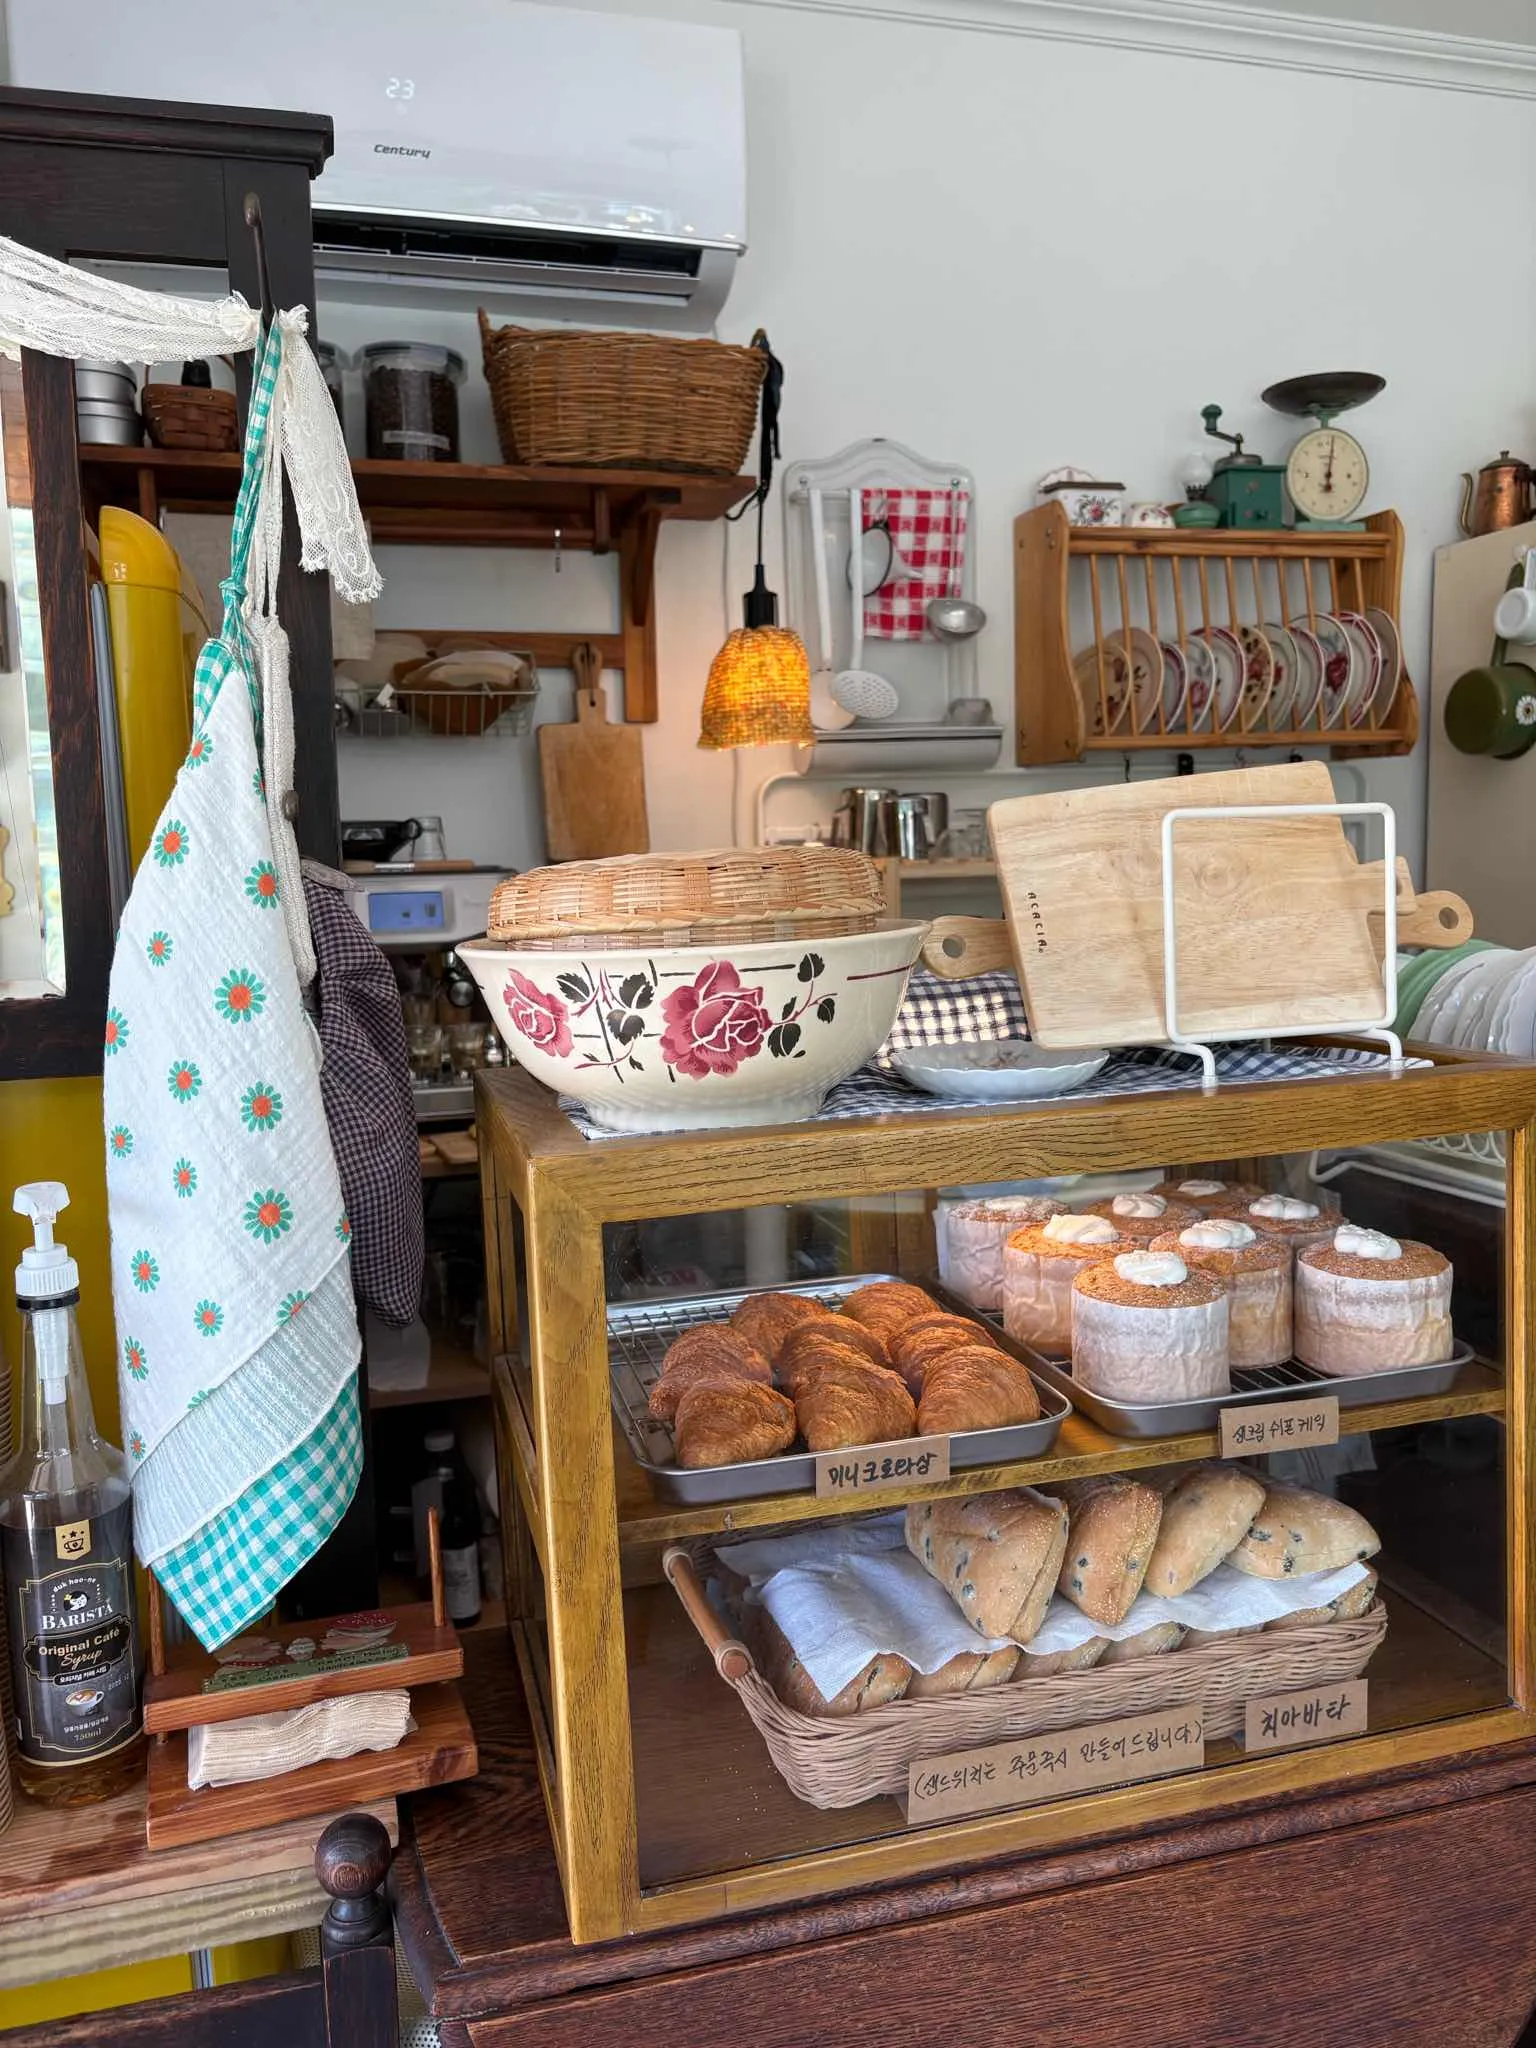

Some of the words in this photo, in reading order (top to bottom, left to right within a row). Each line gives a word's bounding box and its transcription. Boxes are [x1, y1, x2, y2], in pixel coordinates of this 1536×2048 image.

[385, 77, 416, 100] 23
[373, 143, 432, 159] Century
[1027, 892, 1048, 947] ACACIA
[1232, 1422, 1265, 1444] 생크림
[827, 1462, 859, 1488] 미니
[42, 1602, 113, 1630] BARISTA
[38, 1638, 90, 1657] Original
[60, 1649, 103, 1670] Syrup
[1260, 1693, 1352, 1738] 치아바타
